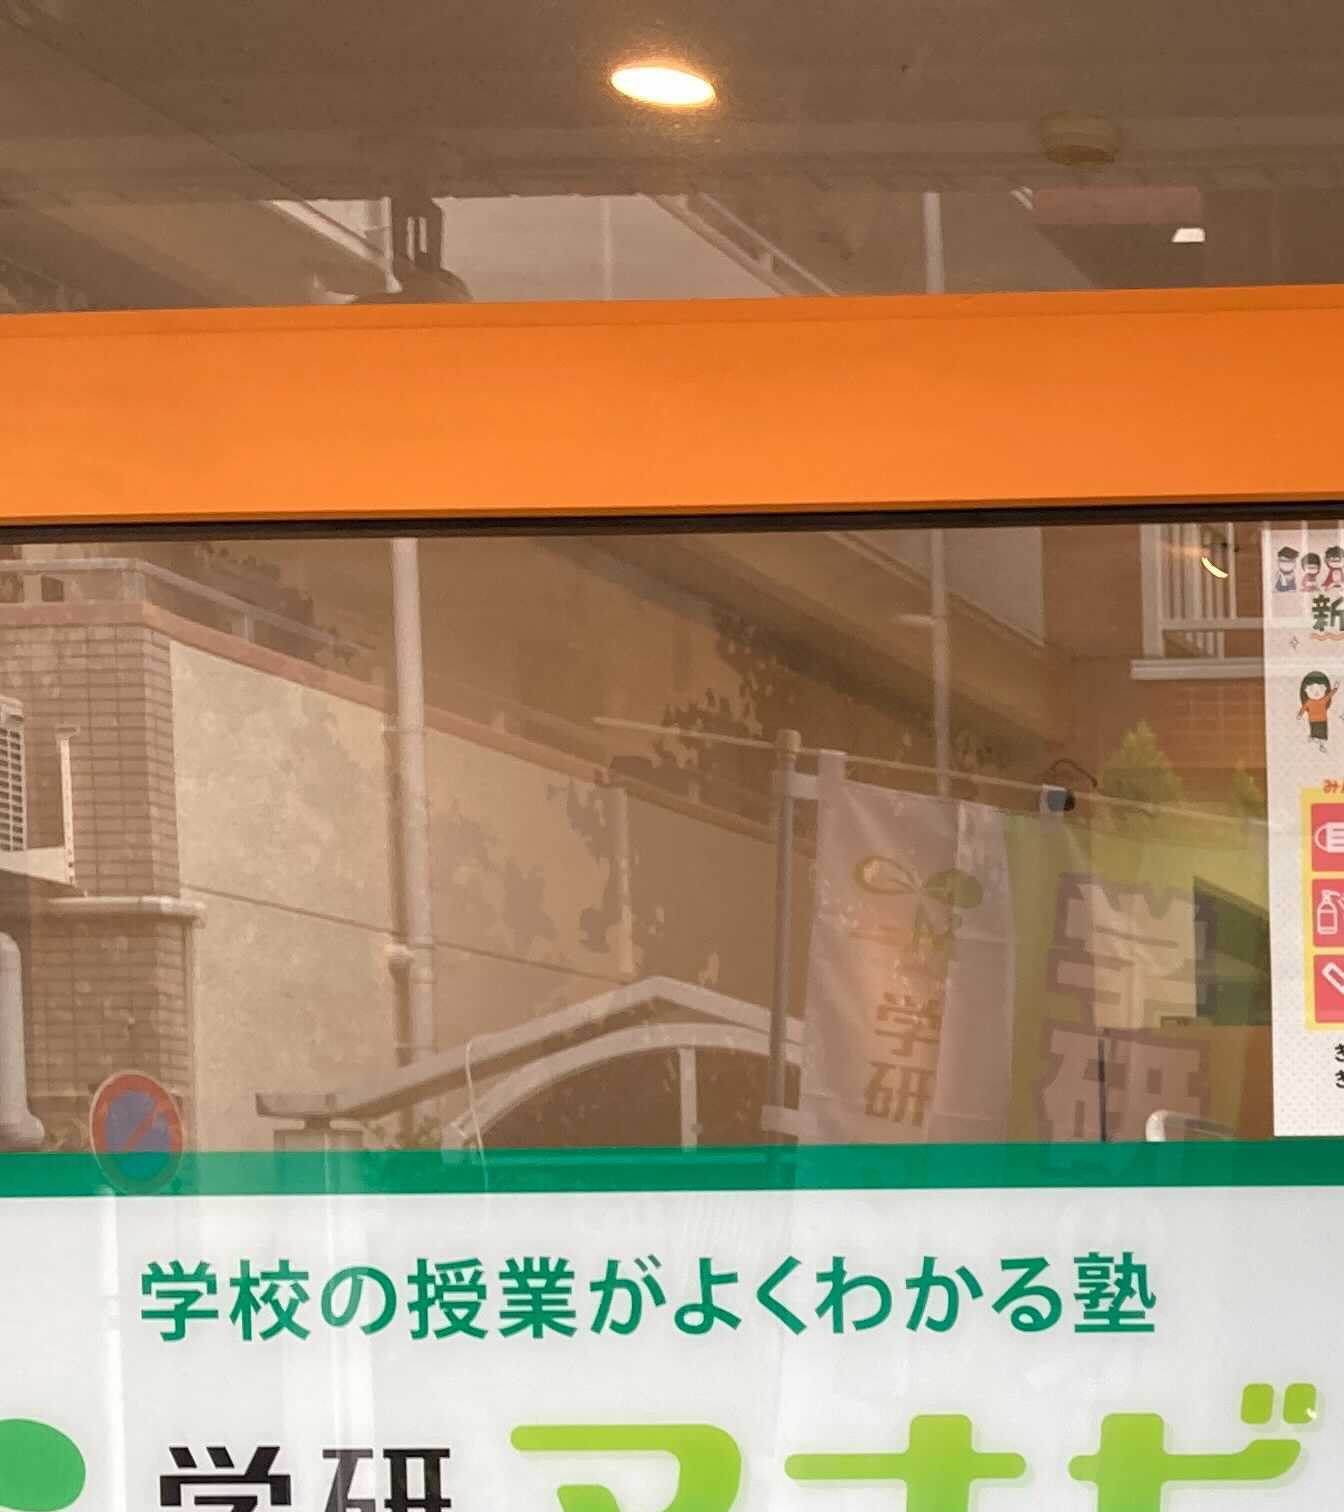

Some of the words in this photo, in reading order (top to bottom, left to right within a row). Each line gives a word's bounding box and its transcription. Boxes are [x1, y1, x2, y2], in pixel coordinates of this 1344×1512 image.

[141, 1252, 1156, 1341] 学校の授業がよくわかる塾
